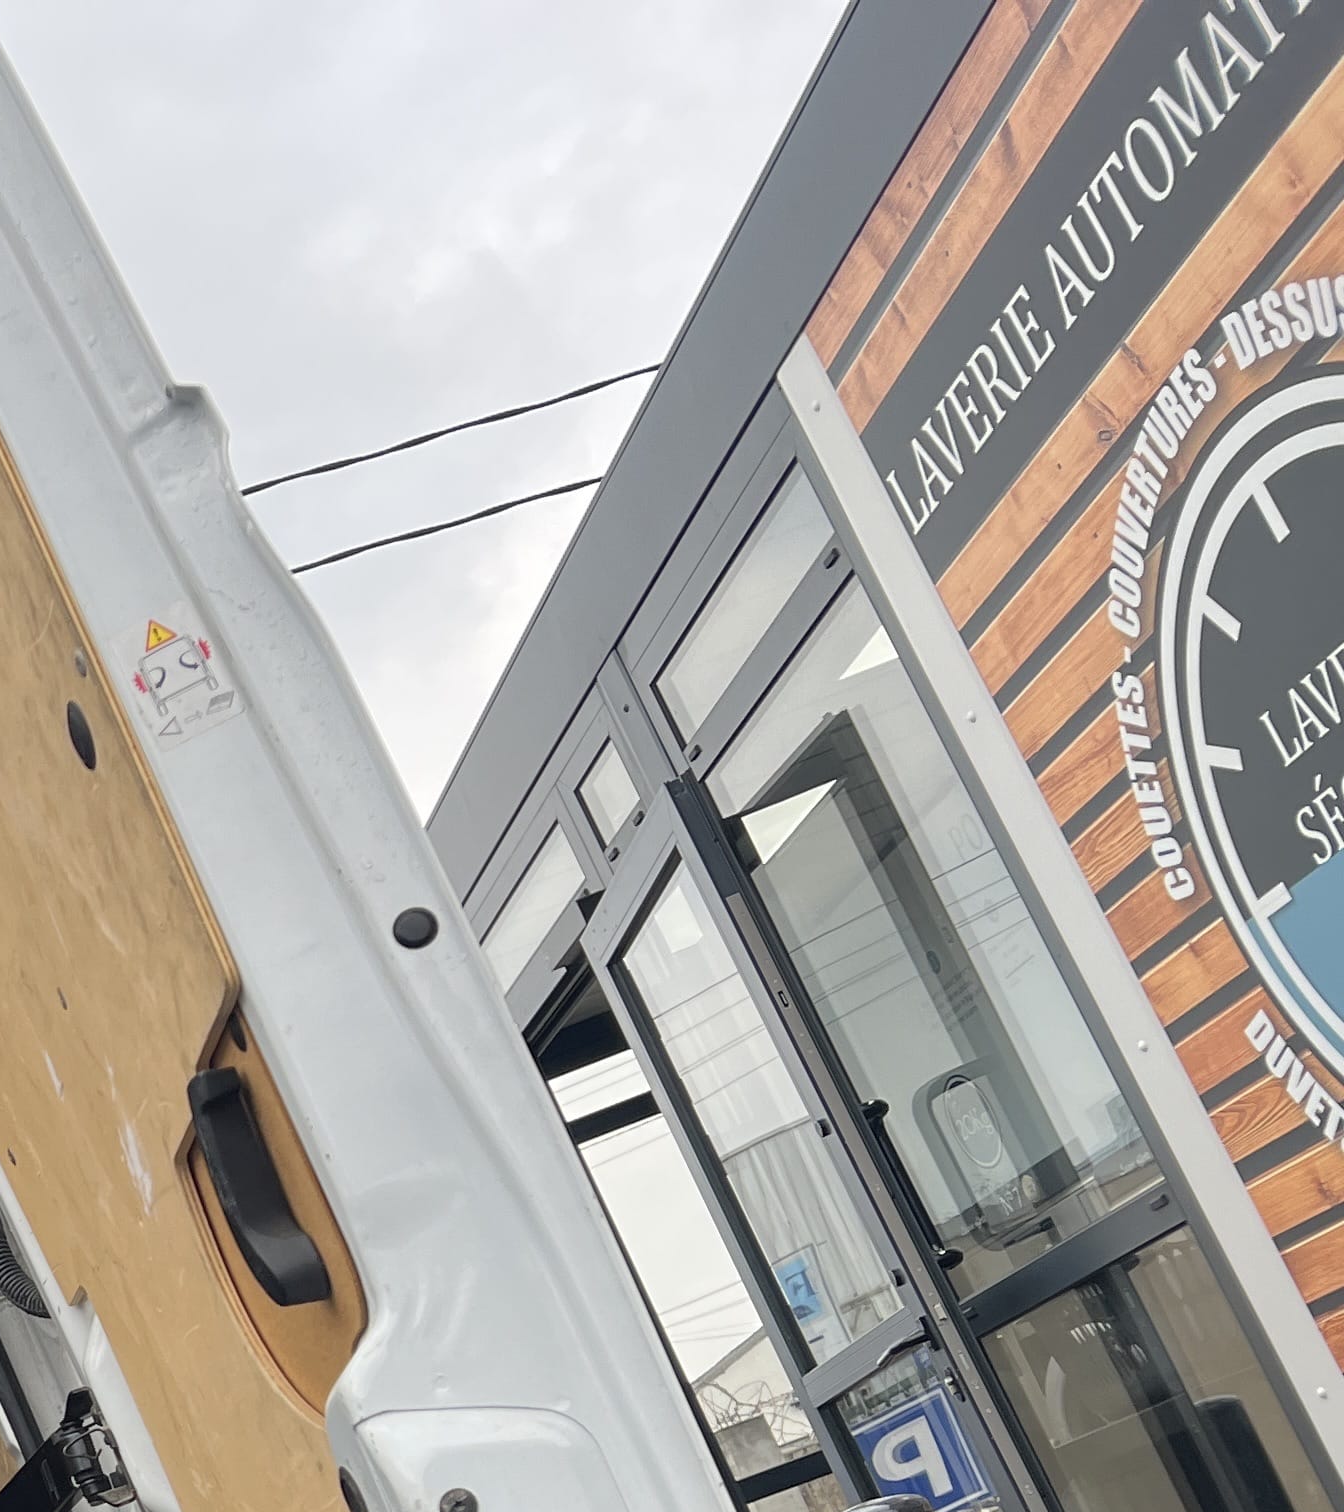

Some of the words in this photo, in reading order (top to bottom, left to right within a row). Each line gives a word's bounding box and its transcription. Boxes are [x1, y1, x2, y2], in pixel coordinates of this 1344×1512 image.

[886, 285, 1056, 535] LAVERIE
[1044, 0, 1312, 330] AUTOMAT
[1108, 347, 1217, 638] COUVERTURES
[1113, 670, 1196, 901] COUETTES
[1244, 1008, 1344, 1153] DUVET
